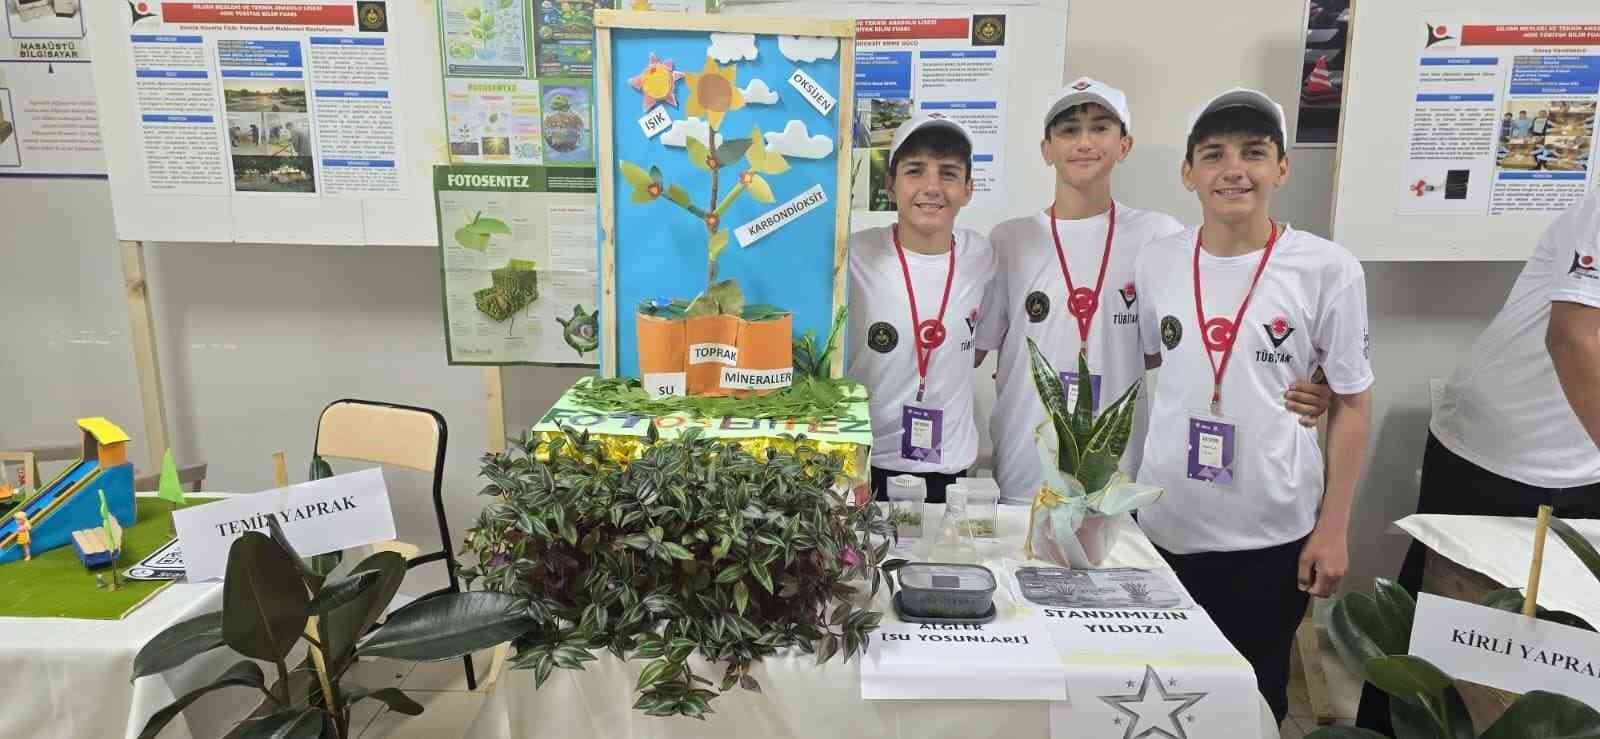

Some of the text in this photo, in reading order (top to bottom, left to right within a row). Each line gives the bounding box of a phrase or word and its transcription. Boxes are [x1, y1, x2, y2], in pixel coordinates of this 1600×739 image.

[20, 41, 75, 50] MASAÜSTÜ
[20, 50, 79, 58] BİLGİSAYAR
[793, 73, 831, 111] OKSİJEN
[644, 111, 665, 131] IŞIK
[447, 174, 530, 188] FOTOSENTEZ
[748, 190, 824, 236] KARBONDİOKSİT
[695, 347, 737, 361] TOPRAK
[725, 371, 792, 385] MİNERALLER
[658, 385, 675, 396] SU
[279, 495, 357, 524] YAPRAK
[1045, 608, 1188, 621] STANDIMIZIN
[1084, 624, 1164, 634] YILDIZI
[882, 633, 1030, 644] [SU YOSUNLARI]
[1451, 628, 1600, 678] KİRLİ YAPRA
